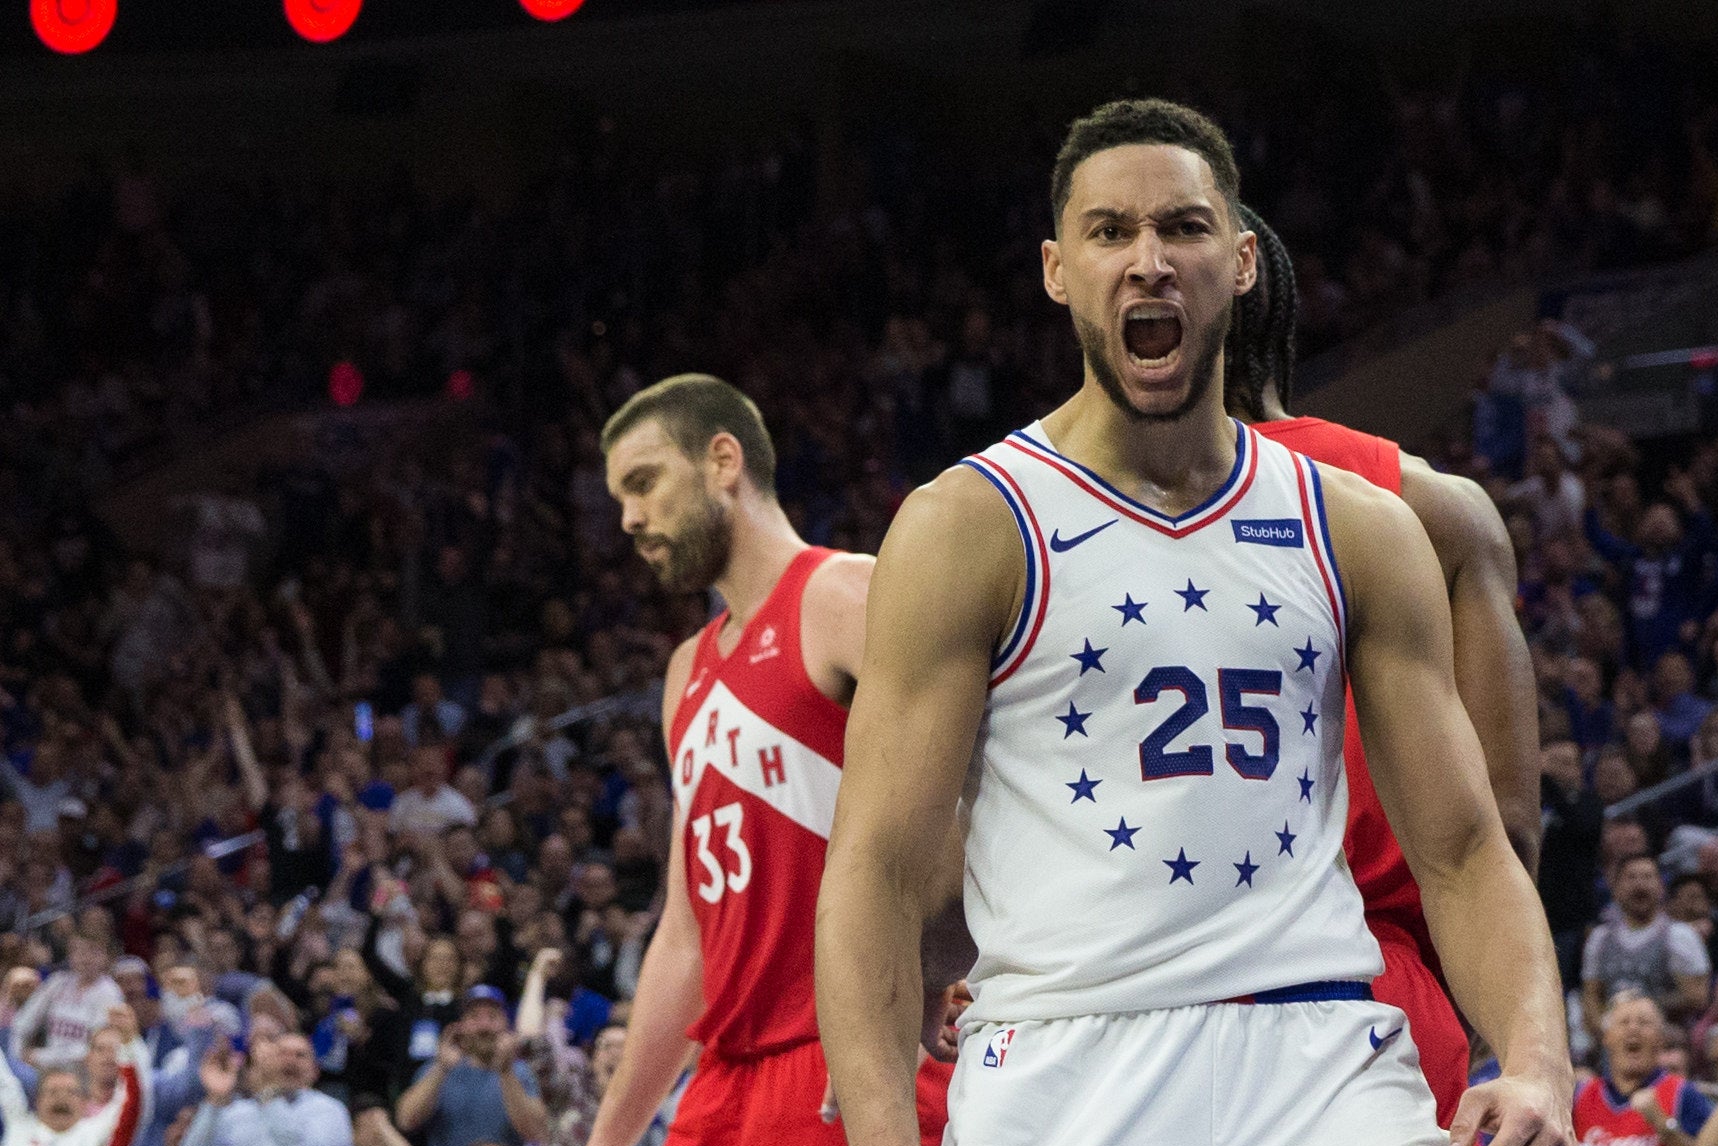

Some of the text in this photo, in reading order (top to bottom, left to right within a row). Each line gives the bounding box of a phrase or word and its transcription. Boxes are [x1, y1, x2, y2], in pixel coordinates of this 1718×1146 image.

[1240, 525, 1296, 540] StubHub
[682, 707, 787, 787] ORTH
[1133, 665, 1283, 782] 25
[692, 802, 753, 905] 33
